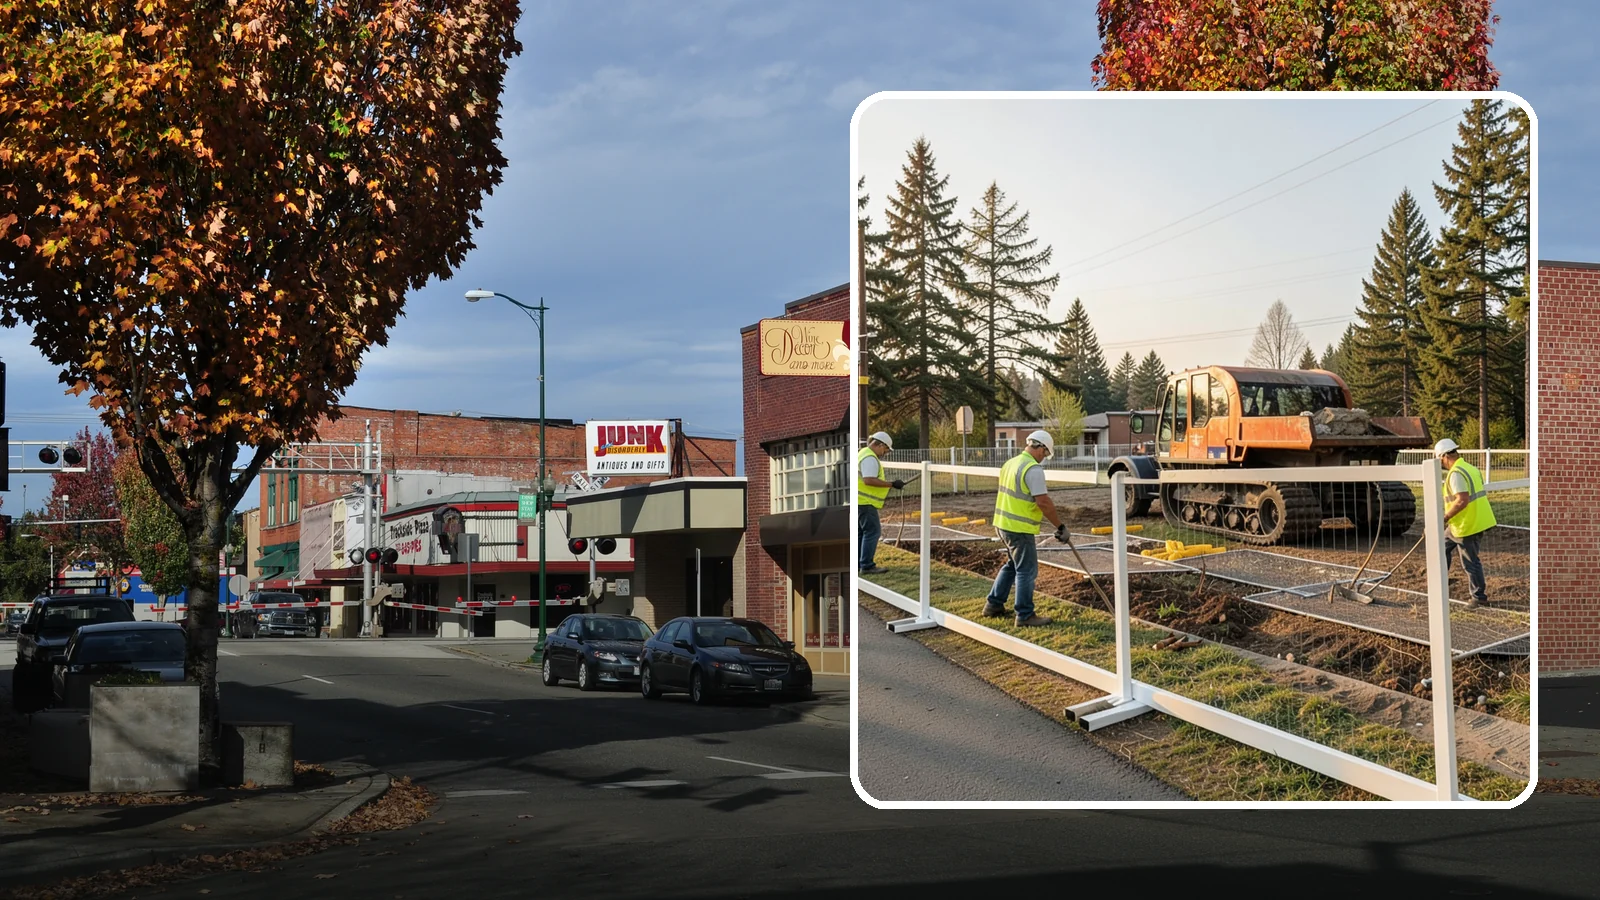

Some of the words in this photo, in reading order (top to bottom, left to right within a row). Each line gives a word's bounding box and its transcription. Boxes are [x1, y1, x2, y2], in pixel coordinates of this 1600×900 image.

[596, 425, 665, 457] JUNK
[607, 446, 646, 454] DISORDERLY
[597, 461, 628, 470] ANTIQUES
[631, 461, 644, 470] AND
[647, 460, 666, 469] GIFTS
[572, 473, 589, 492] RAIL
[590, 476, 608, 491] SING
[352, 498, 364, 511] CRO
